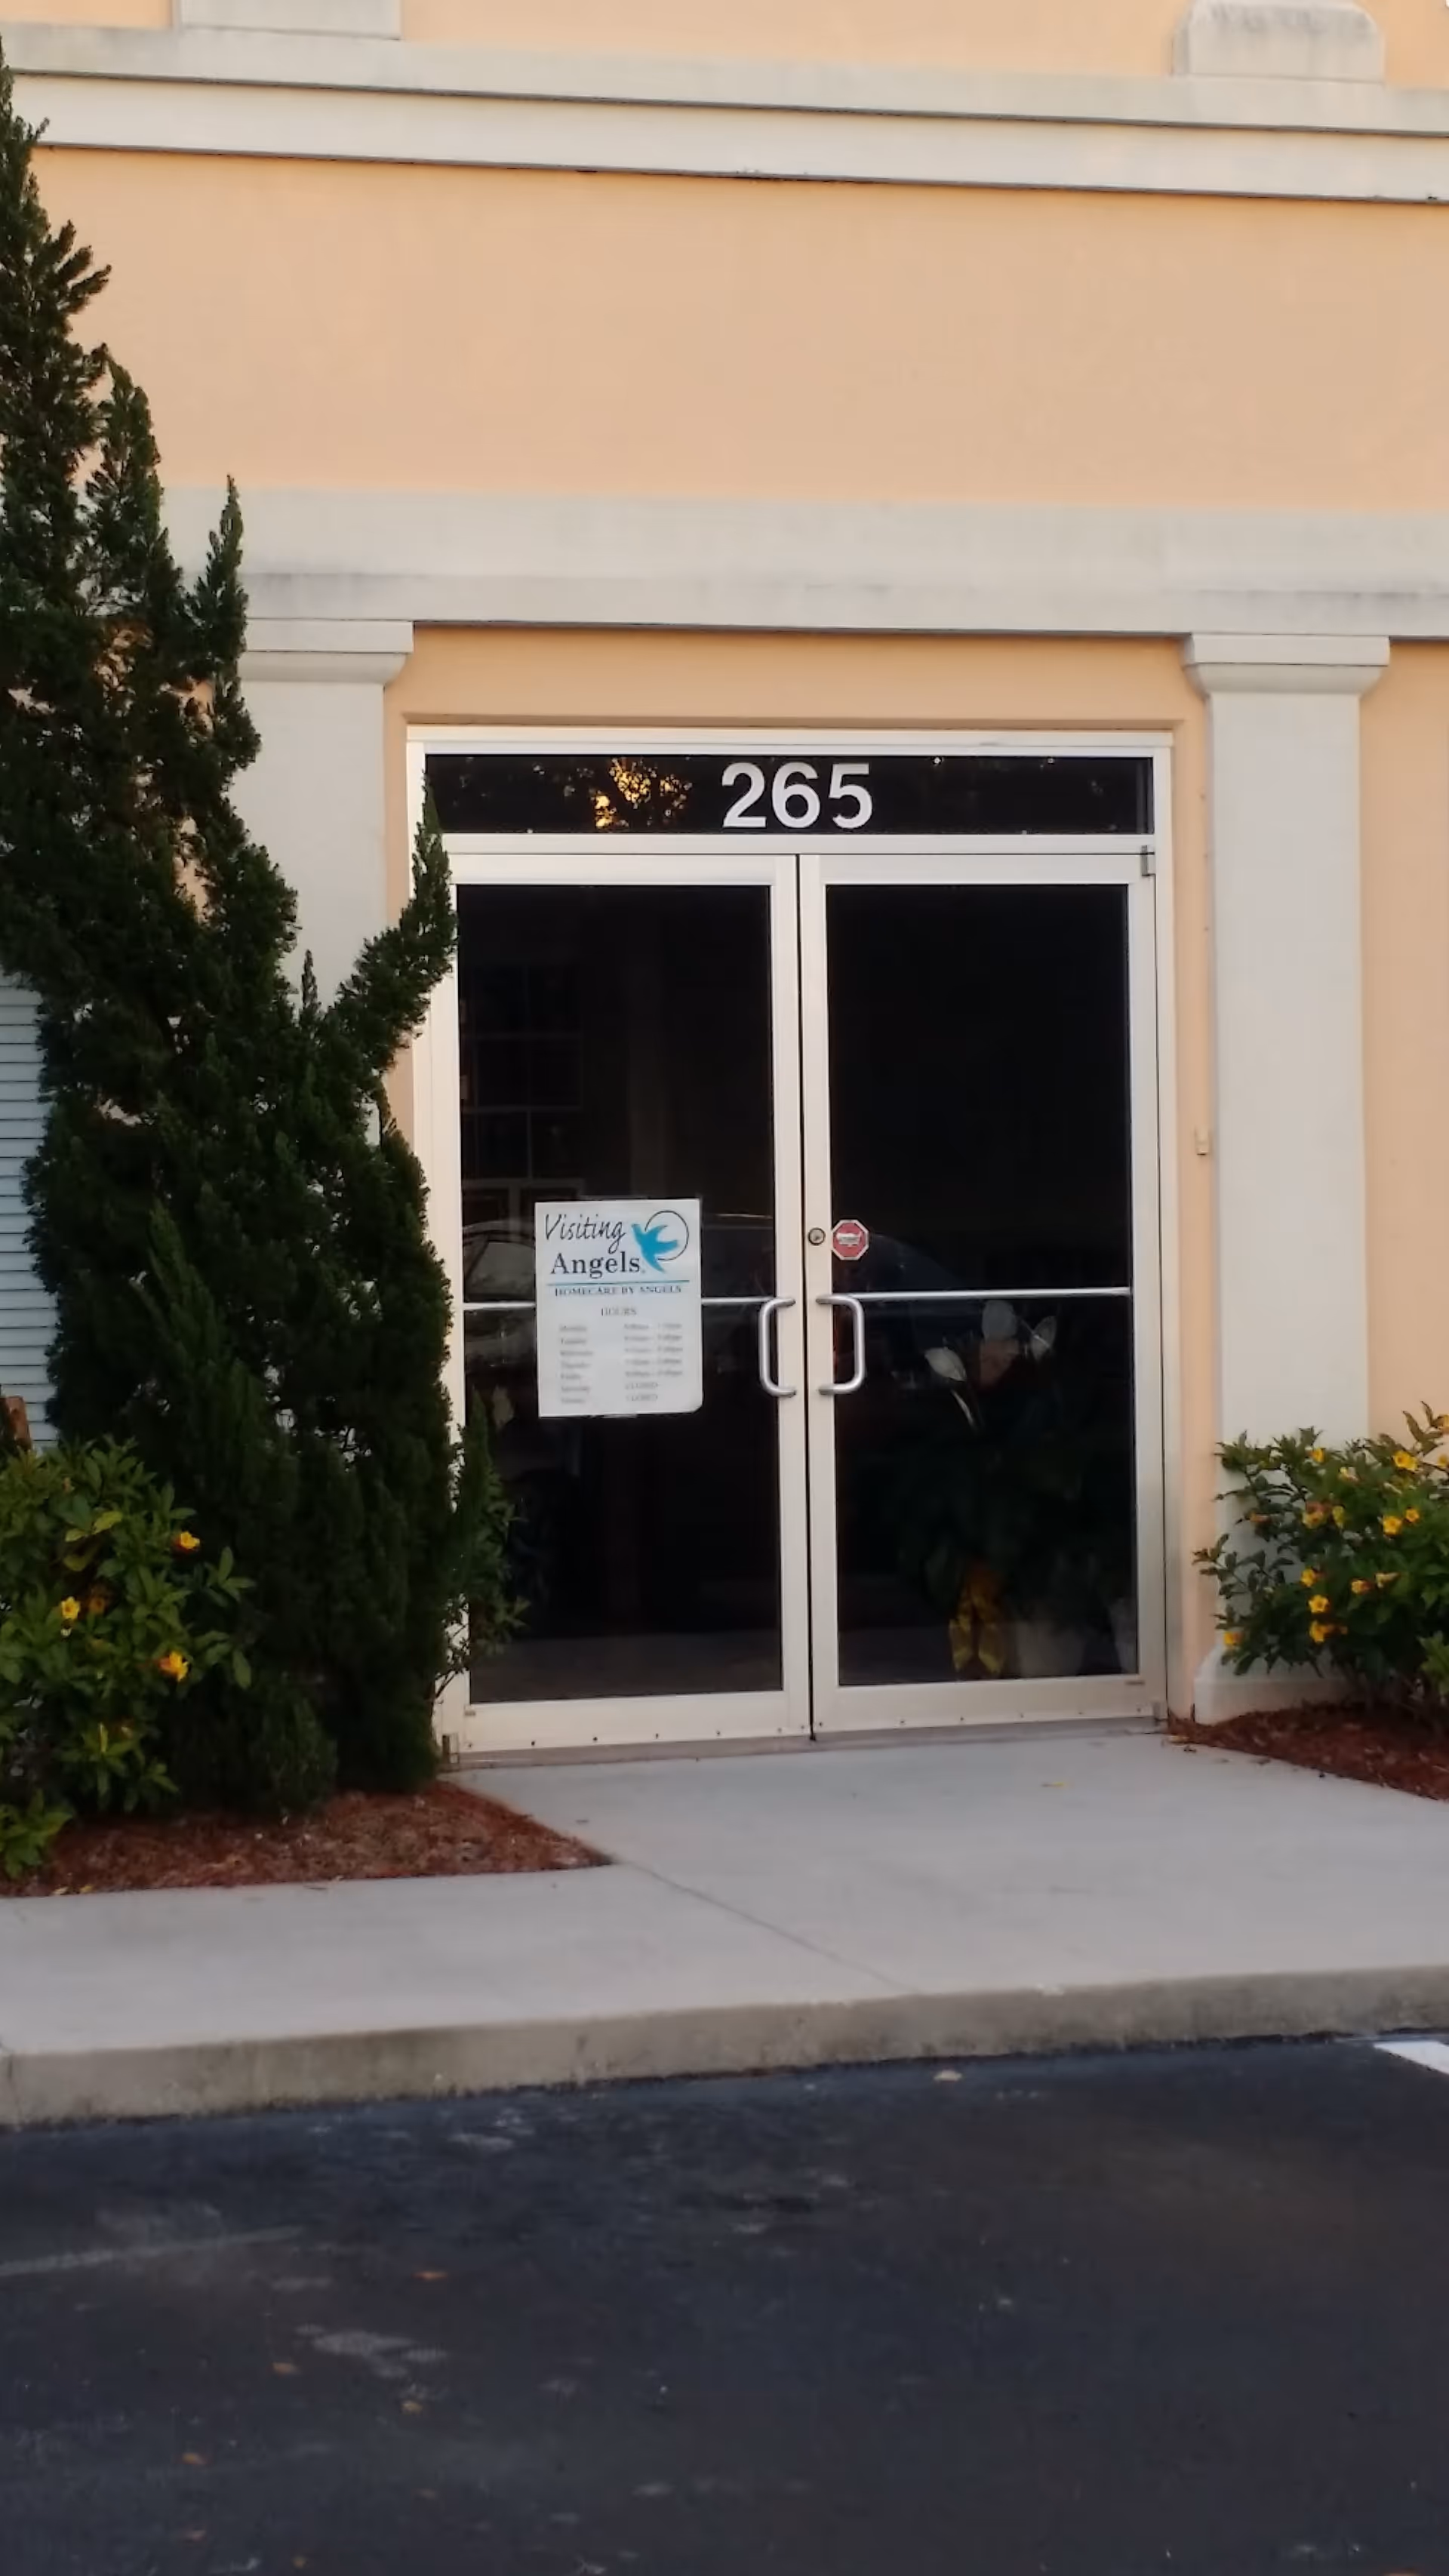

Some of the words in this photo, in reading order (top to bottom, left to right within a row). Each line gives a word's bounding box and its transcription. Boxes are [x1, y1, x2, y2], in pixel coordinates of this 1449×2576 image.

[721, 762, 872, 829] 265
[545, 1213, 626, 1254] Visiting
[551, 1251, 641, 1279] Angels
[555, 1286, 616, 1297] HOMECARE
[621, 1286, 634, 1294] BY
[639, 1285, 681, 1294] ANGELS
[601, 1307, 637, 1316] HOURS
